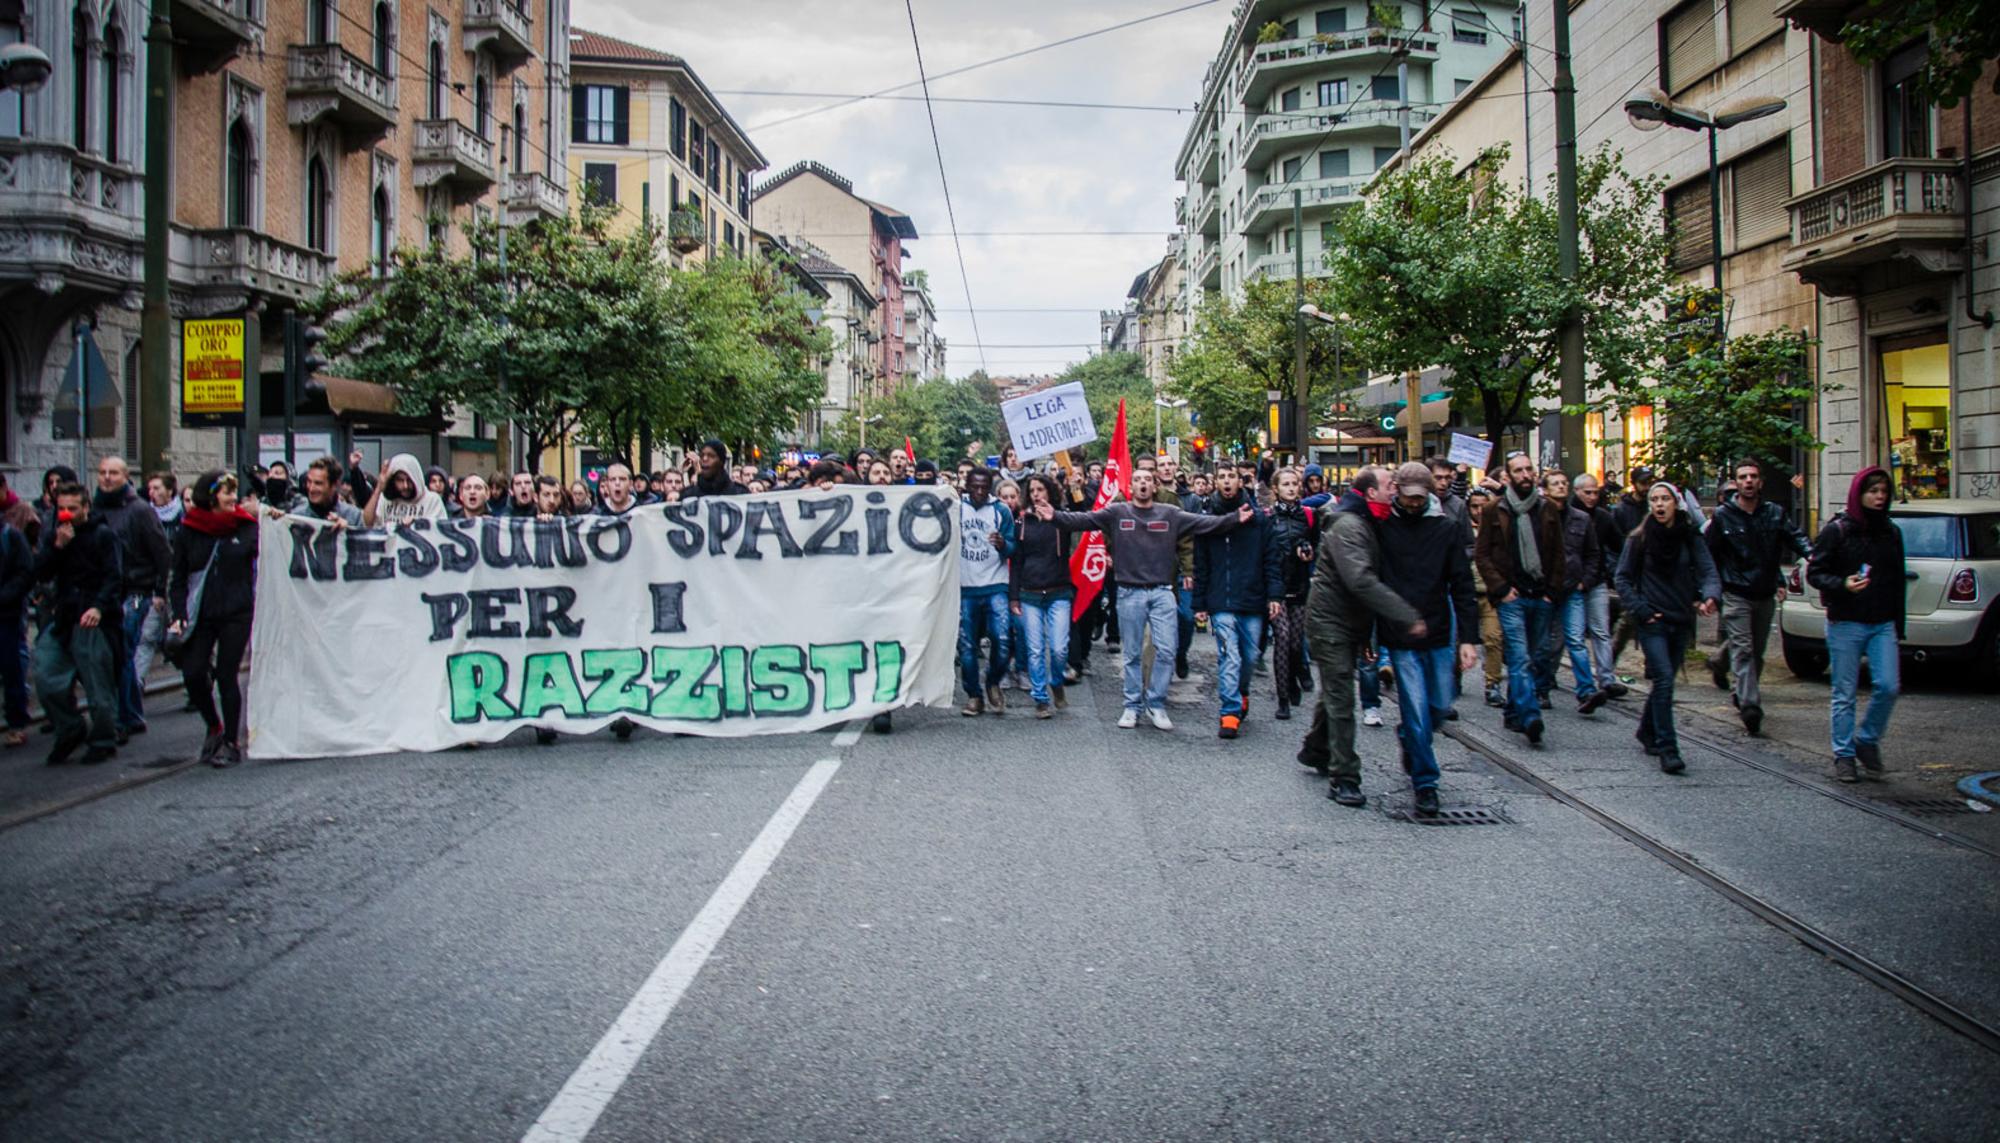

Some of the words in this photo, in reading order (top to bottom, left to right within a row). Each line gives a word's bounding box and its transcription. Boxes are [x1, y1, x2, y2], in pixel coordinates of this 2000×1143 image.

[187, 324, 241, 338] COMPRO
[200, 339, 228, 351] ORO
[1025, 396, 1067, 420] LEGA
[1020, 416, 1088, 450] LADRONA!
[289, 516, 633, 582] NESSUNO
[421, 586, 585, 642] PER
[648, 581, 687, 633] I
